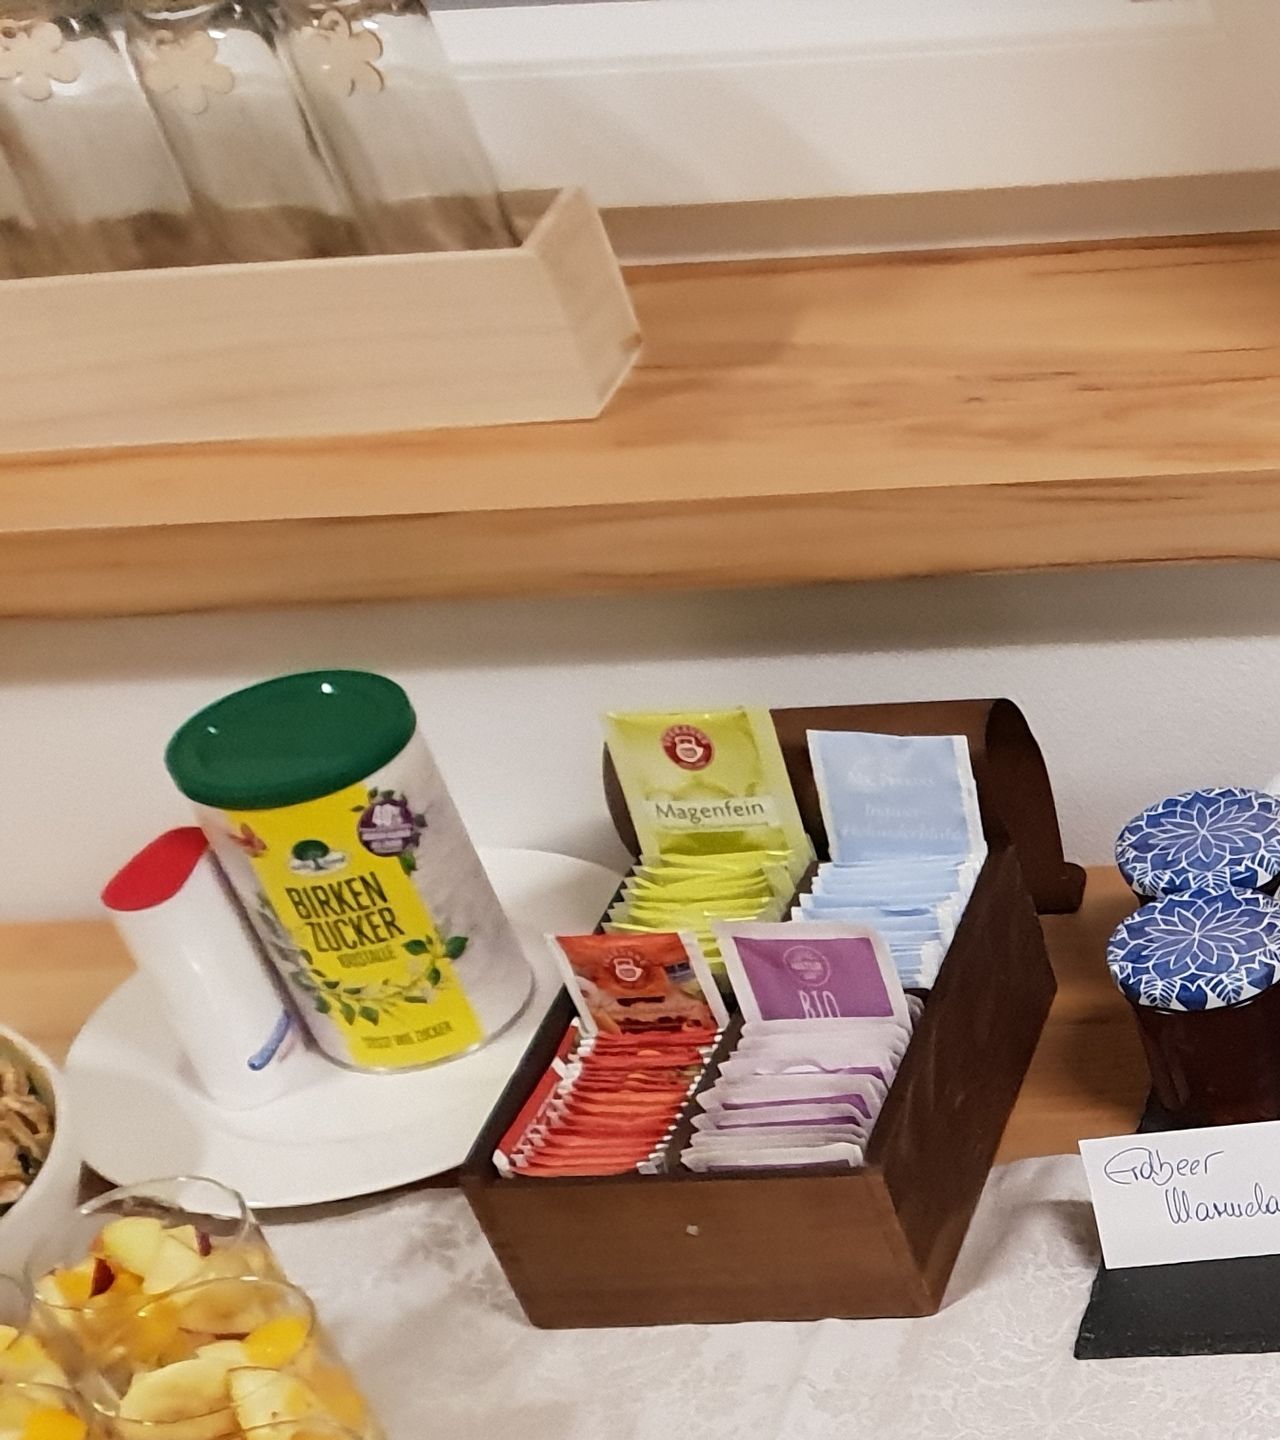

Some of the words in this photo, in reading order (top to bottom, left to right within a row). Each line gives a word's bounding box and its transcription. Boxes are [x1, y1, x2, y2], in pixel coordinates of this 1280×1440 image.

[655, 800, 765, 824] Magenfein
[285, 871, 388, 920] BIRKEN
[305, 907, 405, 953] ZUCKER
[1104, 1146, 1224, 1186] Erdbeer
